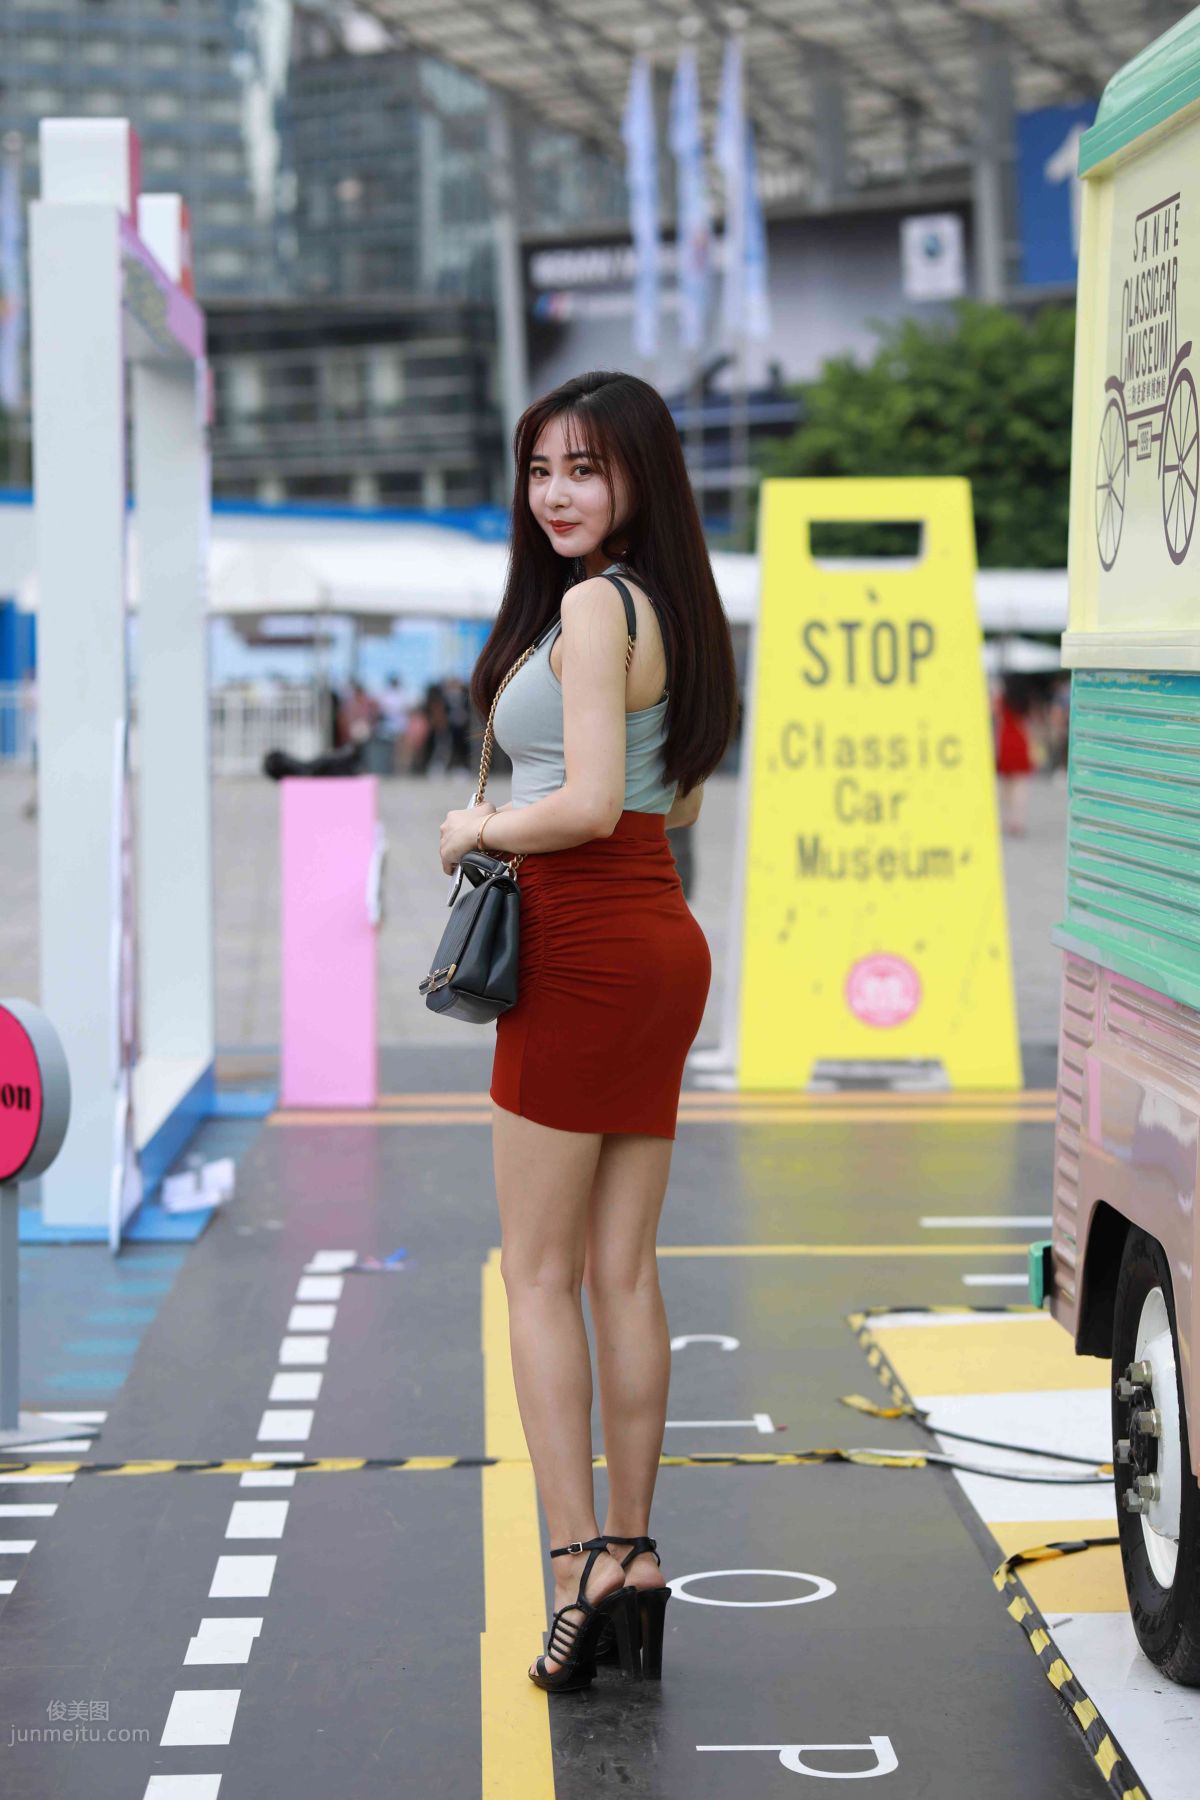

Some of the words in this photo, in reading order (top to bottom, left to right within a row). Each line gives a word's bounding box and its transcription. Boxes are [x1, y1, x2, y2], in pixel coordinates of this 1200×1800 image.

[1132, 193, 1180, 262] SANHE
[1126, 320, 1169, 381] MUSEUM
[800, 619, 936, 688] STOP
[779, 720, 963, 771] Classic
[833, 776, 907, 826] Car
[796, 833, 957, 881] Museum
